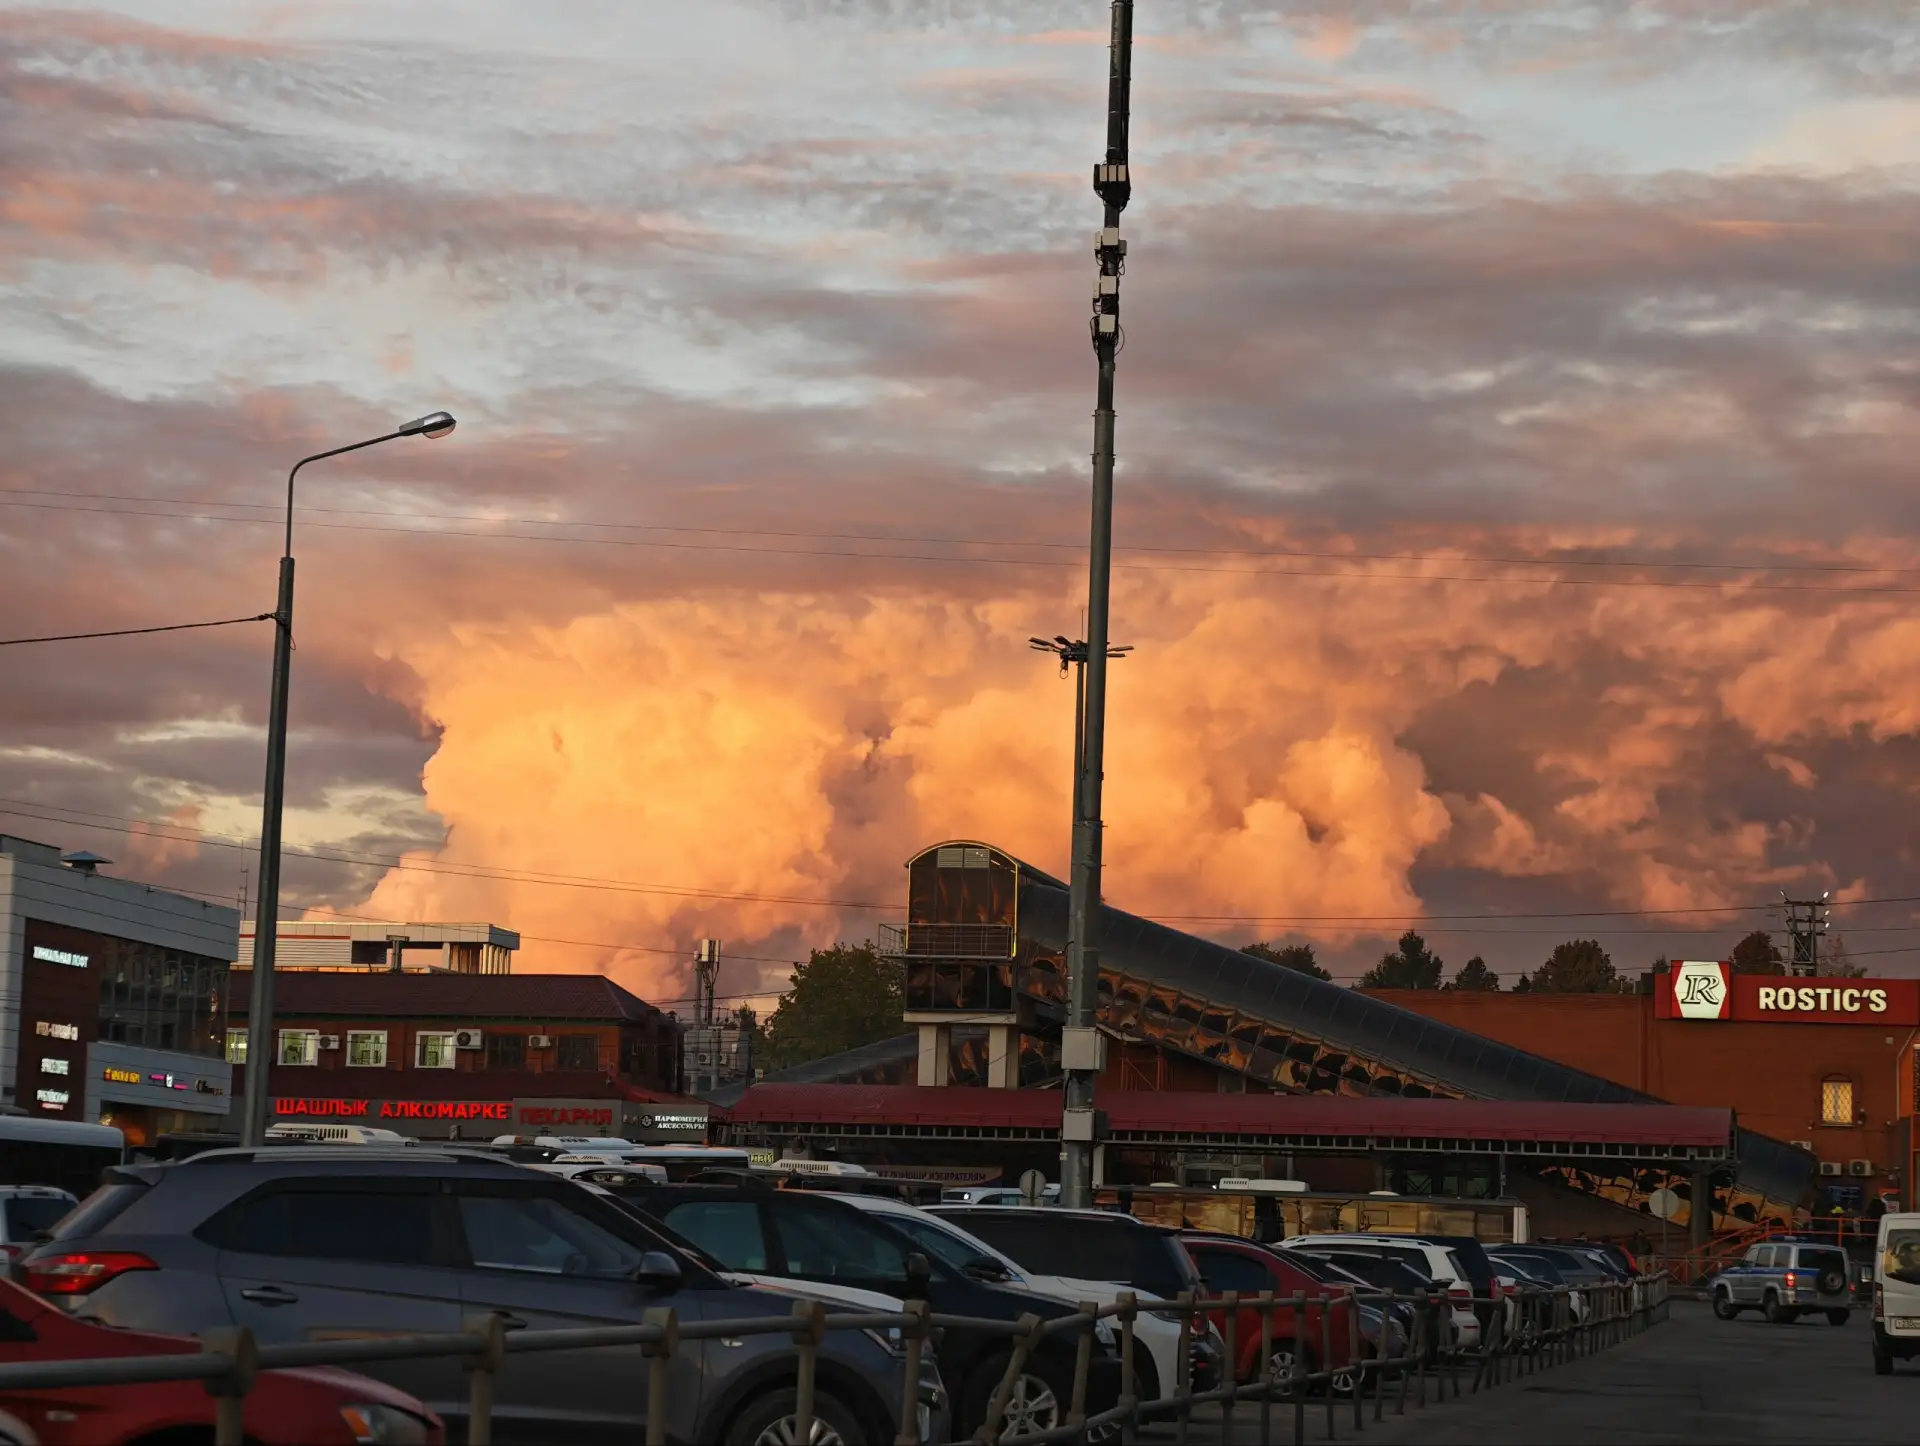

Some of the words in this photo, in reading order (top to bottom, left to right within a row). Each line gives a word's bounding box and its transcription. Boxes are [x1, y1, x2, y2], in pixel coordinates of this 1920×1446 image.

[1680, 974, 1720, 1005] R
[1759, 987, 1887, 1012] ROSTIC'S
[275, 1097, 369, 1116] ШАШЛЫК
[519, 1107, 612, 1125] ПЕКАРНЯ
[655, 1115, 708, 1123] ПАРФЮМЕРИЯ
[749, 1152, 773, 1163] лай
[928, 1171, 986, 1182] ИЗБИРАТЕЛЯМ
